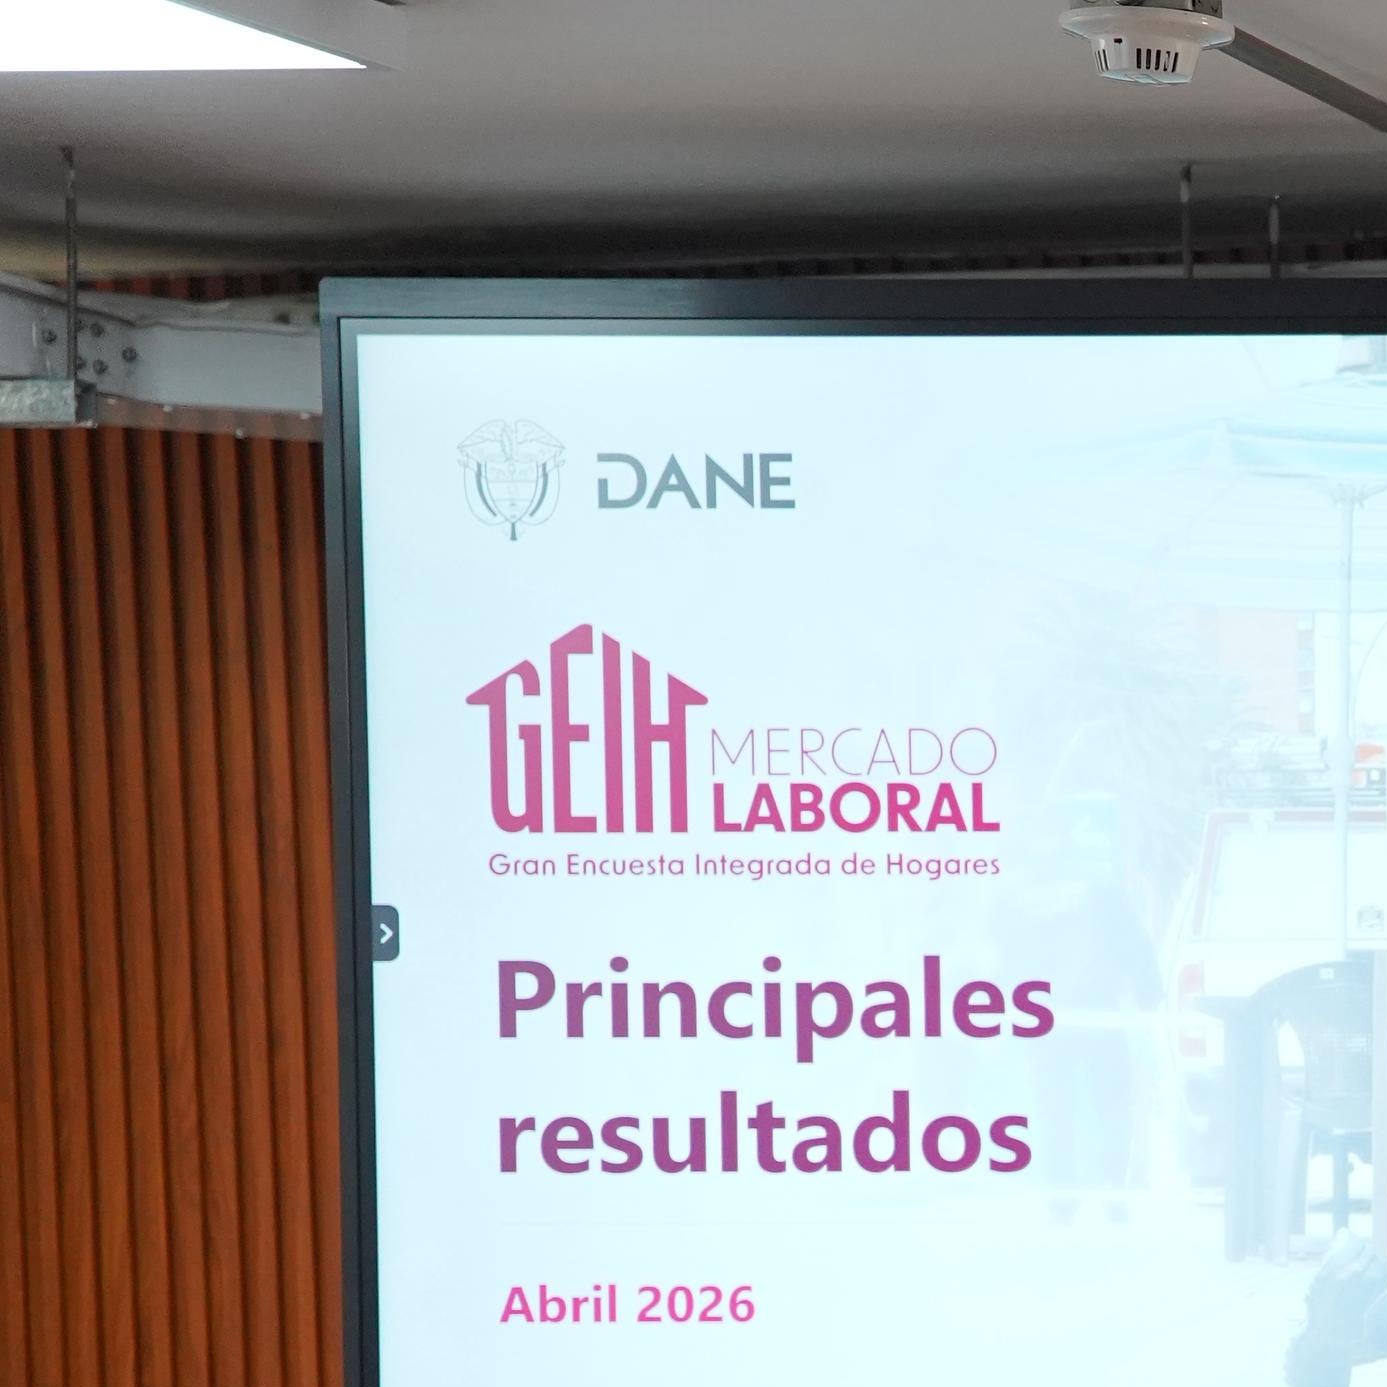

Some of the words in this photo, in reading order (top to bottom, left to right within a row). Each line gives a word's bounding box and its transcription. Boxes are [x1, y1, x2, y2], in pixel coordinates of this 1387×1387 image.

[597, 453, 796, 509] DANE
[465, 623, 709, 834] GEIH
[711, 727, 997, 776] MERCADO
[713, 782, 1001, 833] LABORAL
[489, 853, 556, 876] Gran
[567, 853, 684, 876] Encuesta
[695, 852, 831, 881] Integrada
[841, 852, 875, 875] de
[886, 853, 1001, 881] Hogares
[498, 955, 1055, 1063] Principales
[499, 1090, 1032, 1173] resultados
[500, 1284, 617, 1323] Abril
[636, 1285, 756, 1323] 2026
